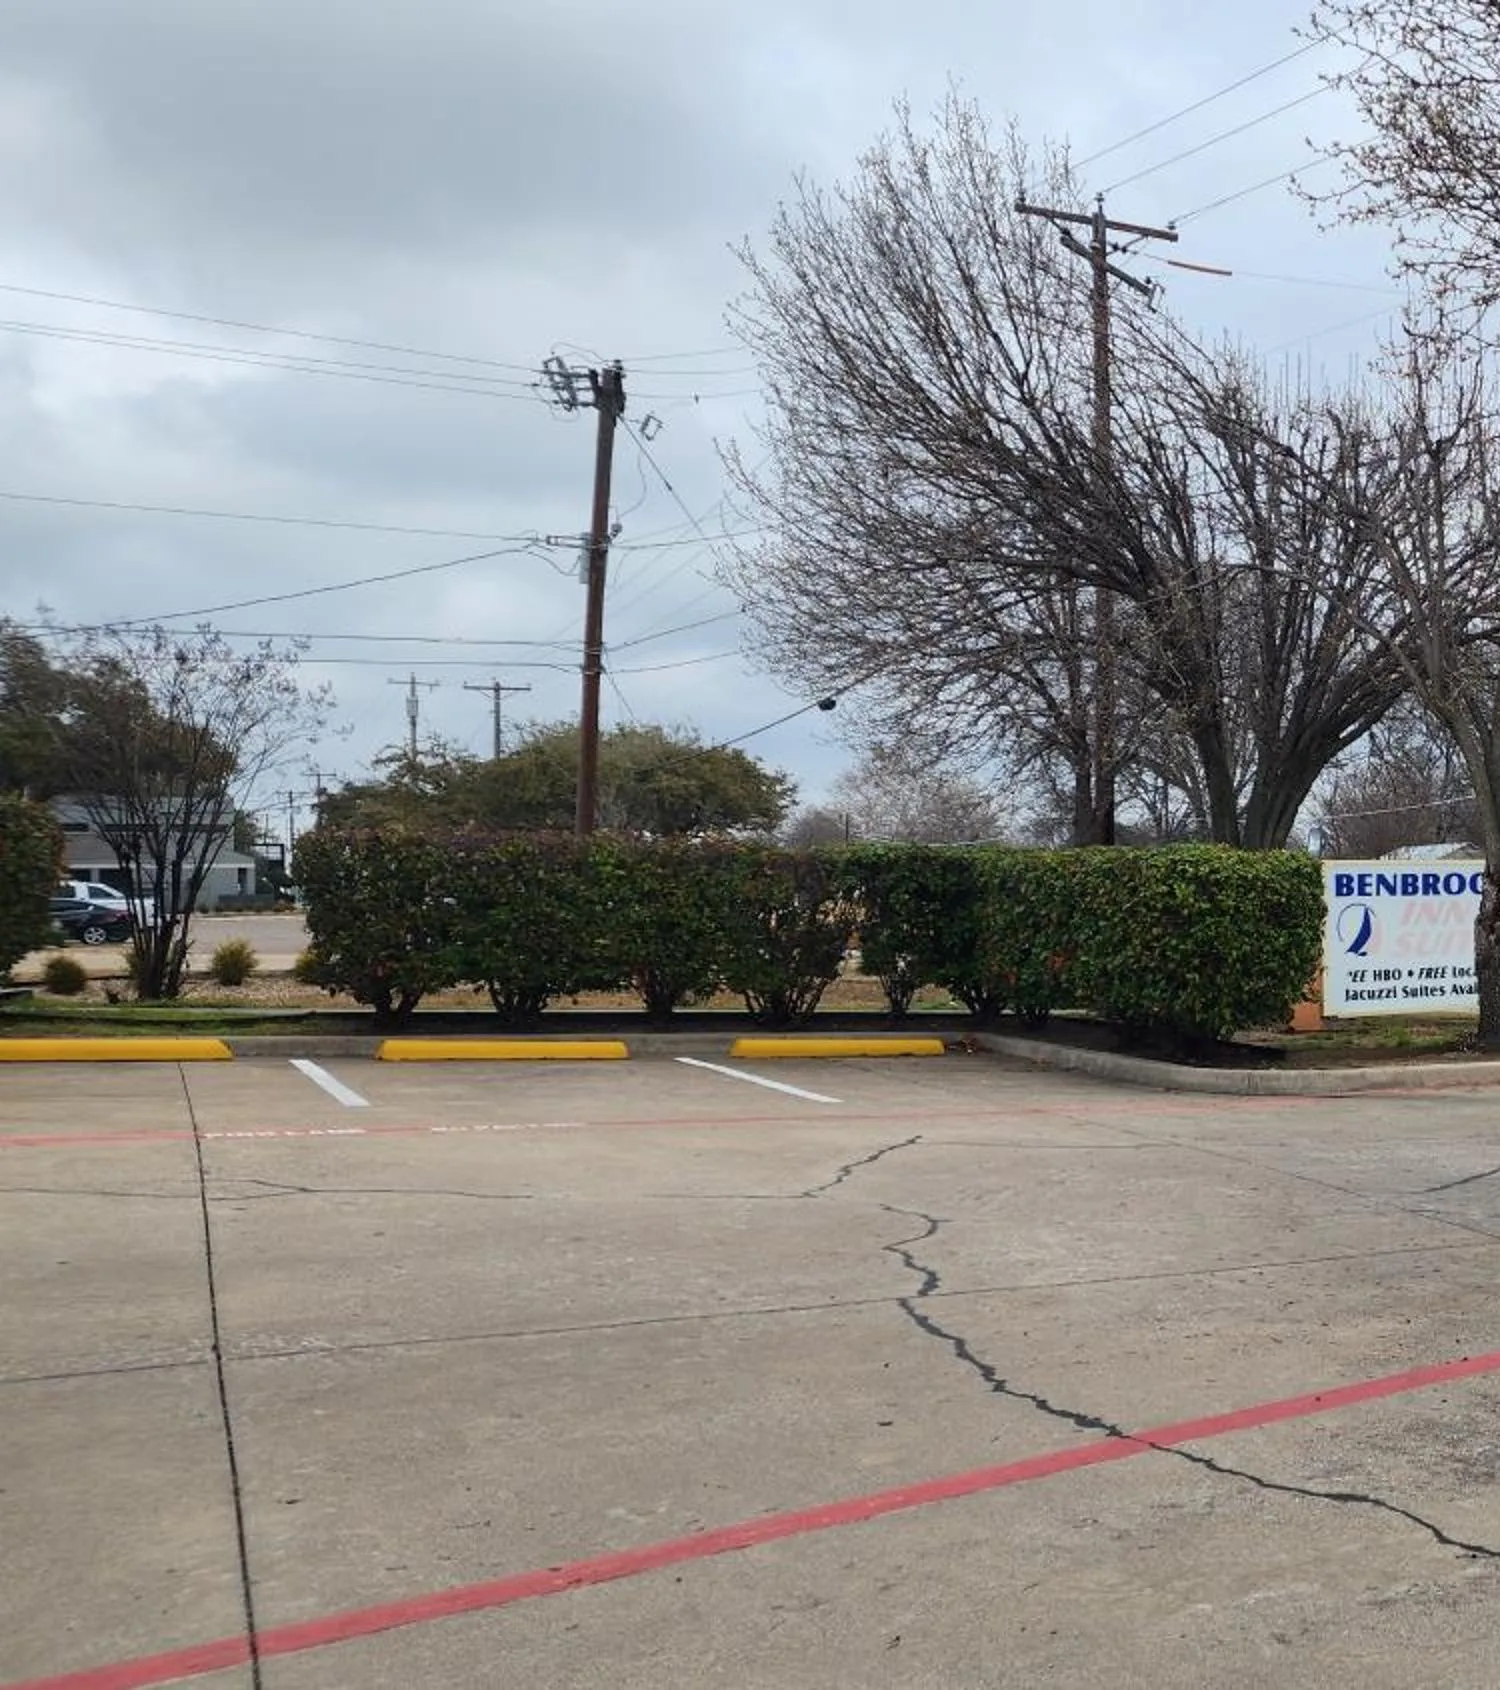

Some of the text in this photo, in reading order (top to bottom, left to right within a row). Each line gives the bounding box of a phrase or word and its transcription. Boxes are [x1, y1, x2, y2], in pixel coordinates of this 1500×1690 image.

[1372, 968, 1402, 982] HBO
[1417, 965, 1449, 980] FREE
[1344, 985, 1397, 1002] Jacuzzi
[1400, 984, 1446, 999] Suites
